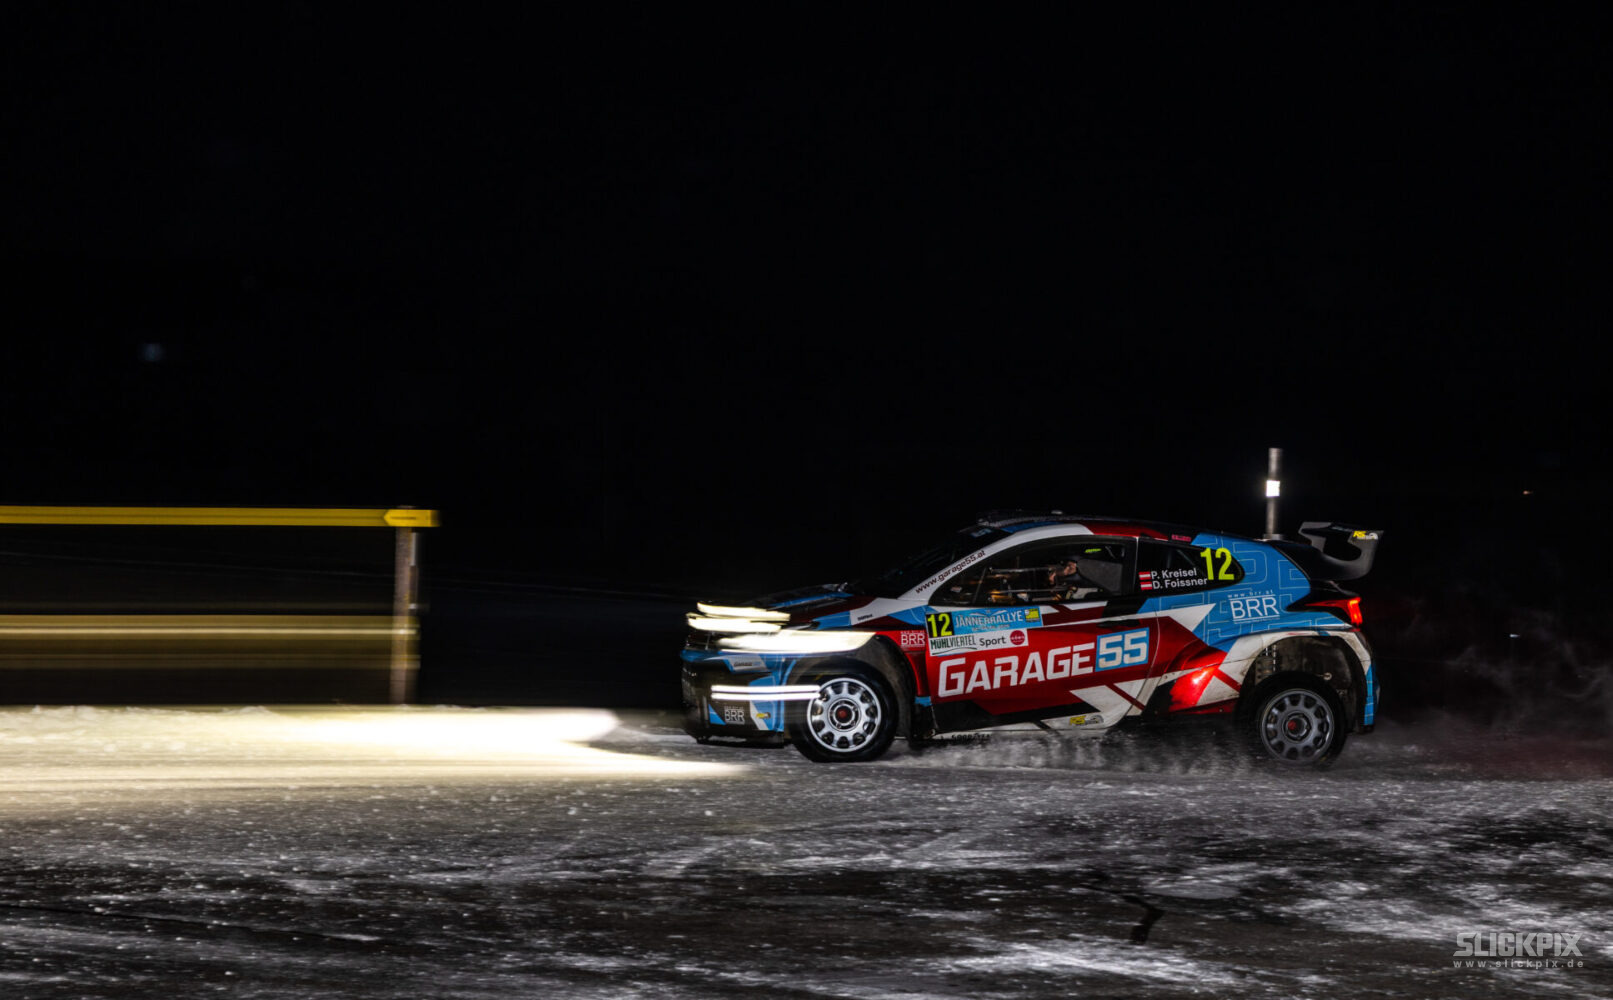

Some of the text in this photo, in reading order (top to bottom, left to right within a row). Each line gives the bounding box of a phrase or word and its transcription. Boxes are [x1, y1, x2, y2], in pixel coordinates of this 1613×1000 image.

[915, 550, 986, 593] www.garage55.at
[1200, 547, 1235, 580] 12
[1150, 568, 1197, 580] P. Kreisel
[1152, 578, 1208, 589] D. Foissner
[1230, 597, 1280, 619] BRR
[927, 613, 953, 638] 12
[955, 610, 1024, 628] JÄNNERRALLYE
[901, 633, 926, 645] BRR
[930, 635, 977, 650] MÜHLVIERTEL
[980, 636, 1006, 647] Sport
[725, 709, 745, 721] BRR
